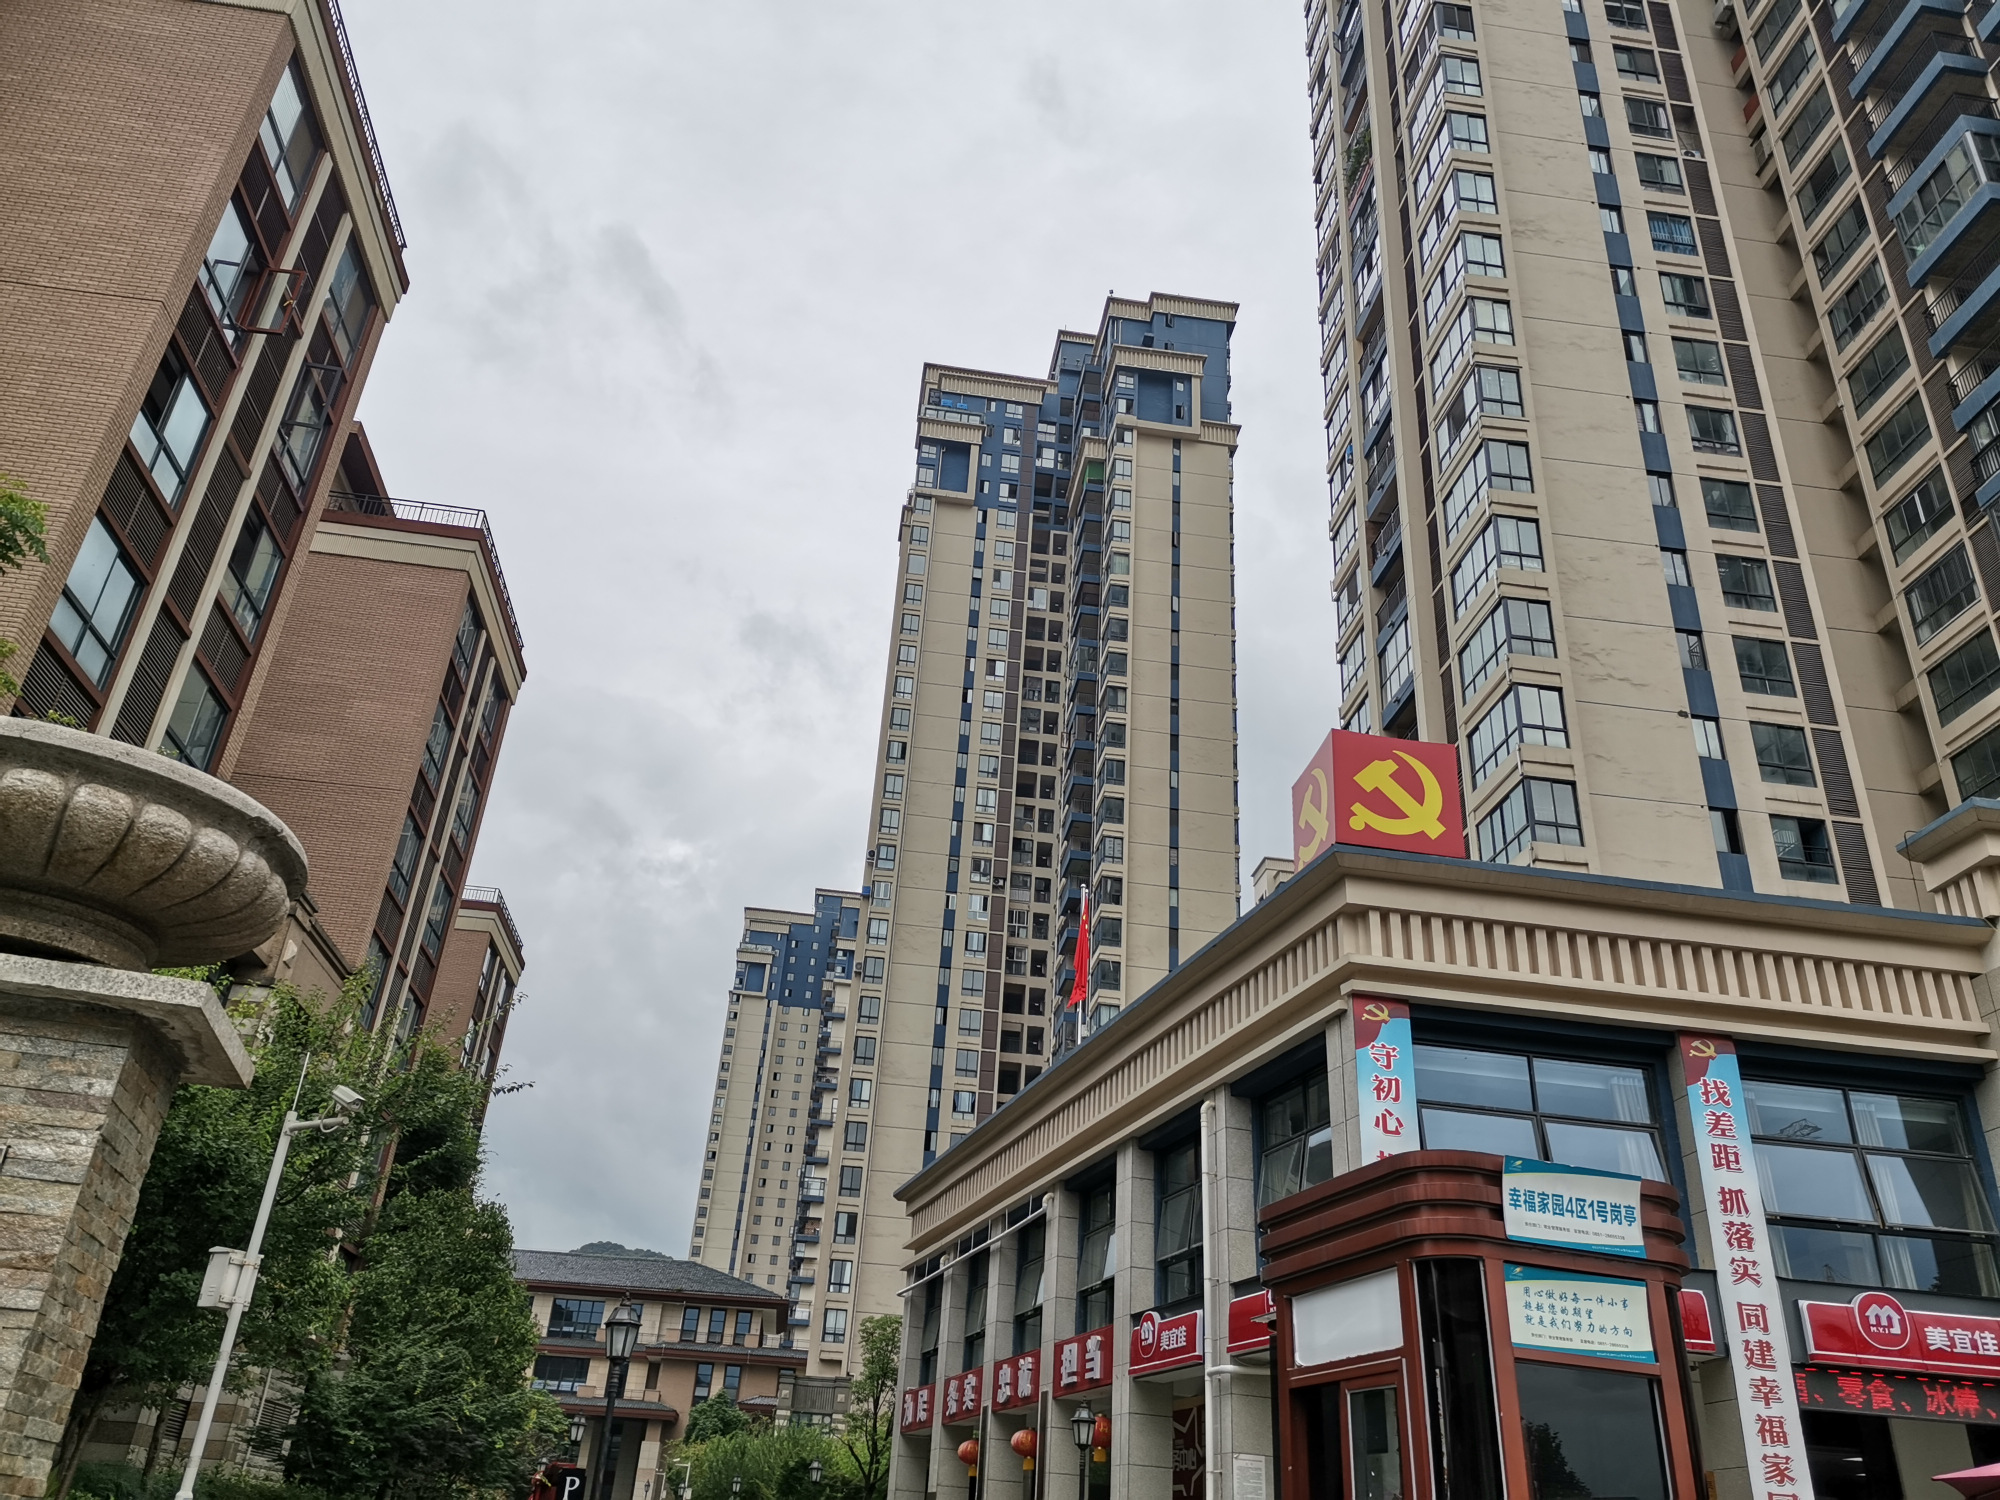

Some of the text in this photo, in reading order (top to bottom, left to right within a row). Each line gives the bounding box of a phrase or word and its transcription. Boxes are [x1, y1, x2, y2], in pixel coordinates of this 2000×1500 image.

[1369, 1042, 1404, 1136] 守初心
[1508, 1187, 1637, 1227] 幸福家园4区1号岗亭
[1523, 1286, 1629, 1311] 用心做好每一件小事
[1700, 1078, 1801, 1500] 找差距 抓落实 同建幸福家
[1523, 1301, 1594, 1319] 超越您的期望
[1524, 1314, 1633, 1338] 就是我们努力的方向
[1160, 1325, 1187, 1351] 美宜佳
[1924, 1325, 2000, 1356] 美宜佳
[1060, 1335, 1104, 1387] 担当
[946, 1374, 976, 1417] 务实
[997, 1357, 1033, 1404] 忠诚
[562, 1476, 580, 1500] P
